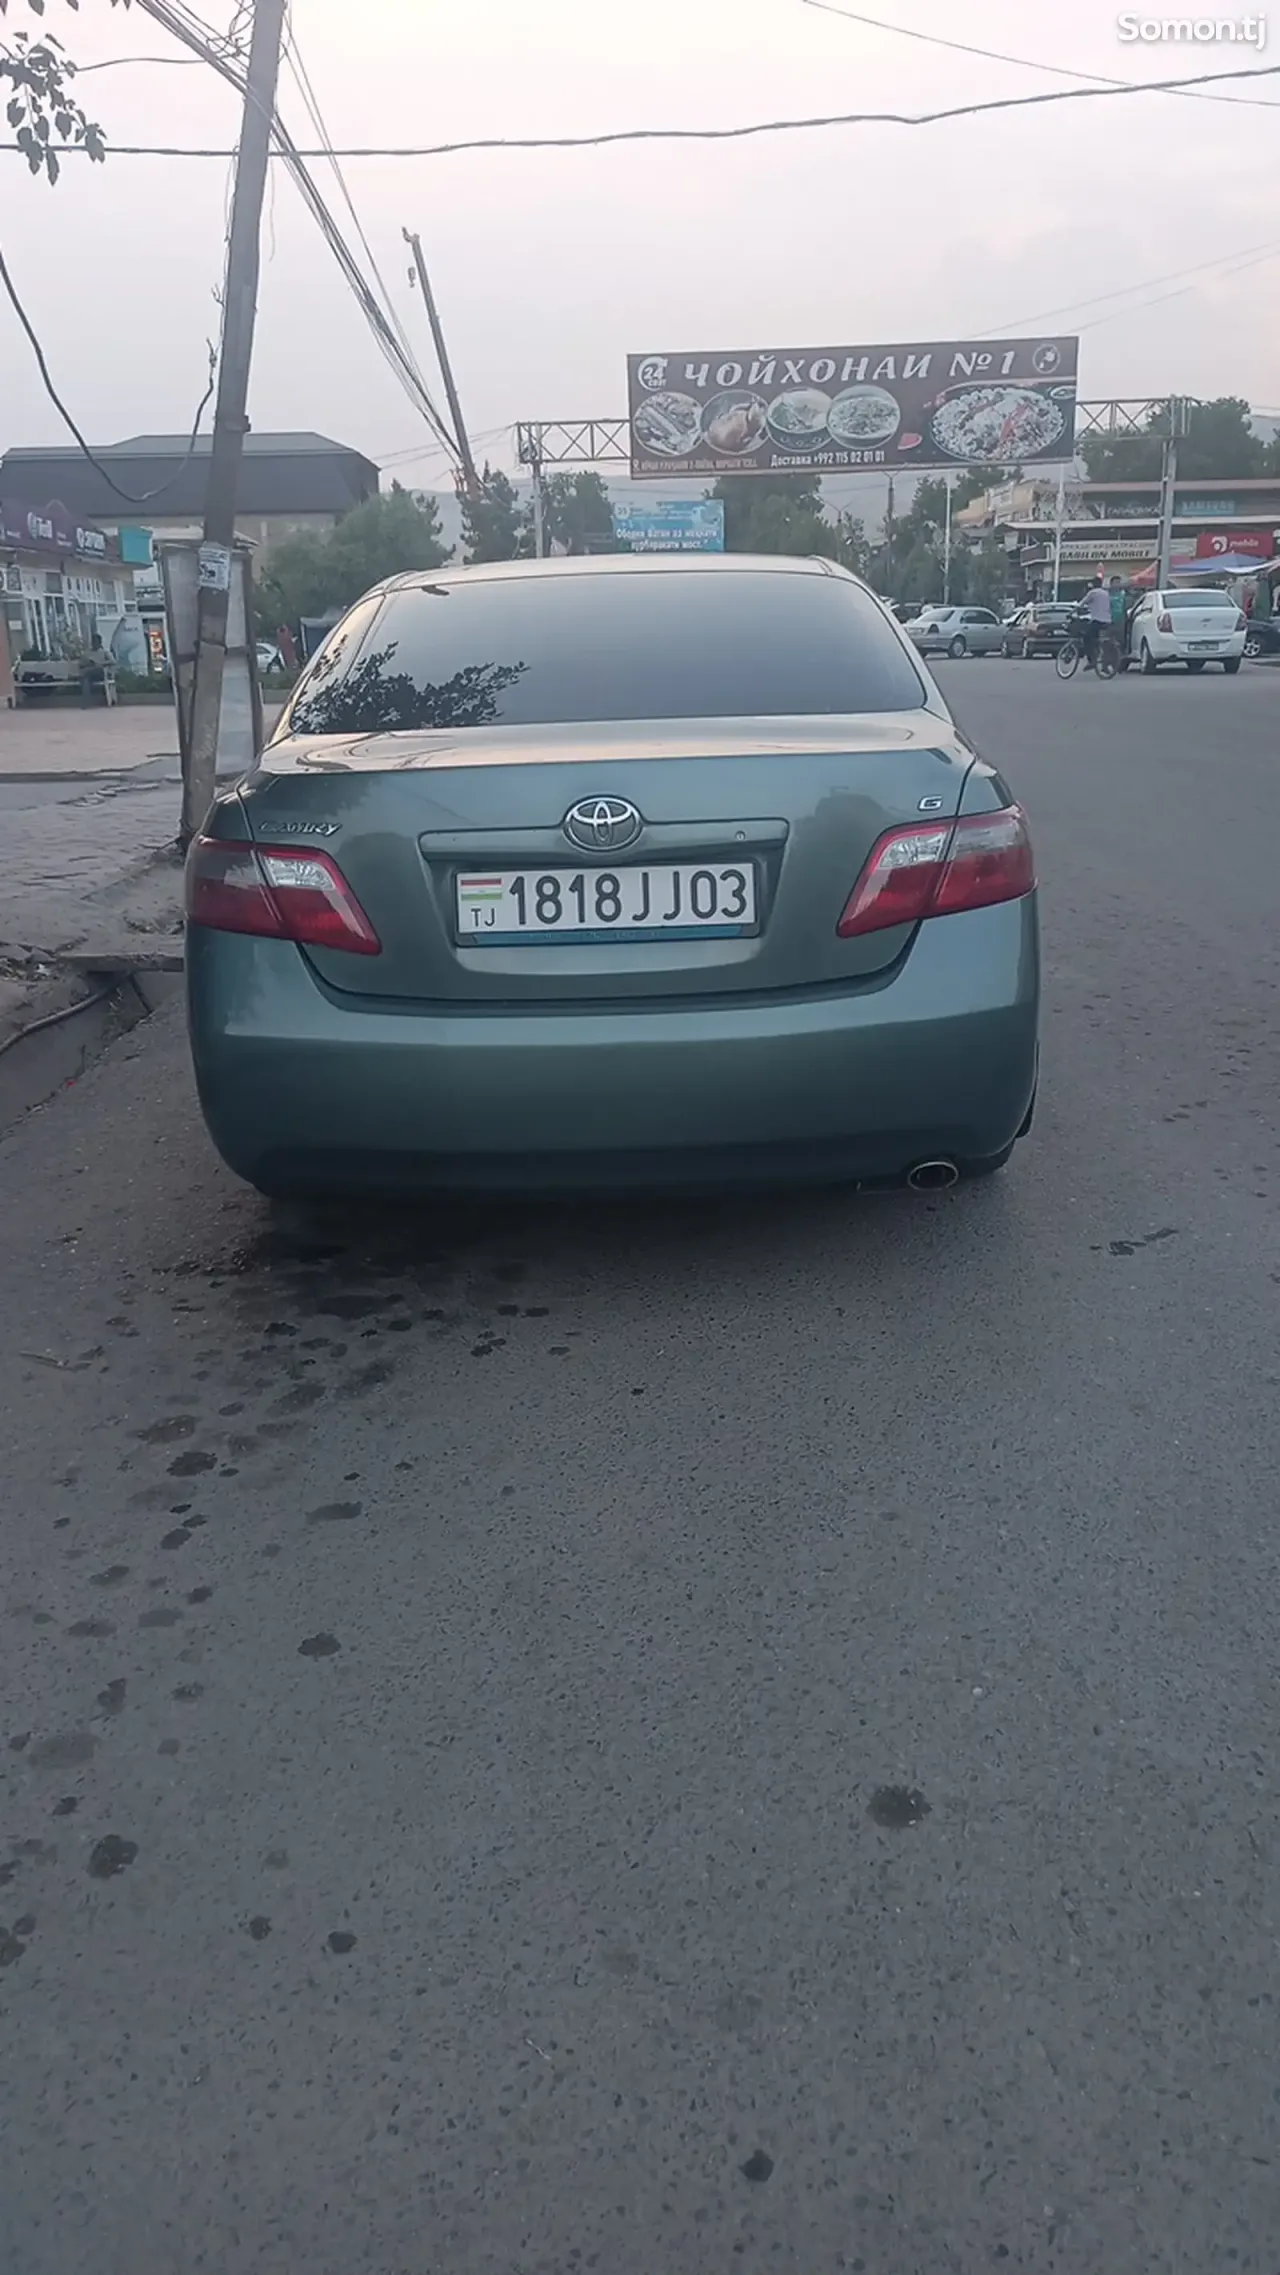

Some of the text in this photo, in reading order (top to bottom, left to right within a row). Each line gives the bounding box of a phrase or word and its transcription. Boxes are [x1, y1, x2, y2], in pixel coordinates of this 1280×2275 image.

[643, 366, 665, 381] 24
[684, 354, 932, 388] ЧОЙХОНАИ
[771, 454, 812, 468] Доставка
[919, 795, 943, 811] G
[470, 907, 496, 928] TJ
